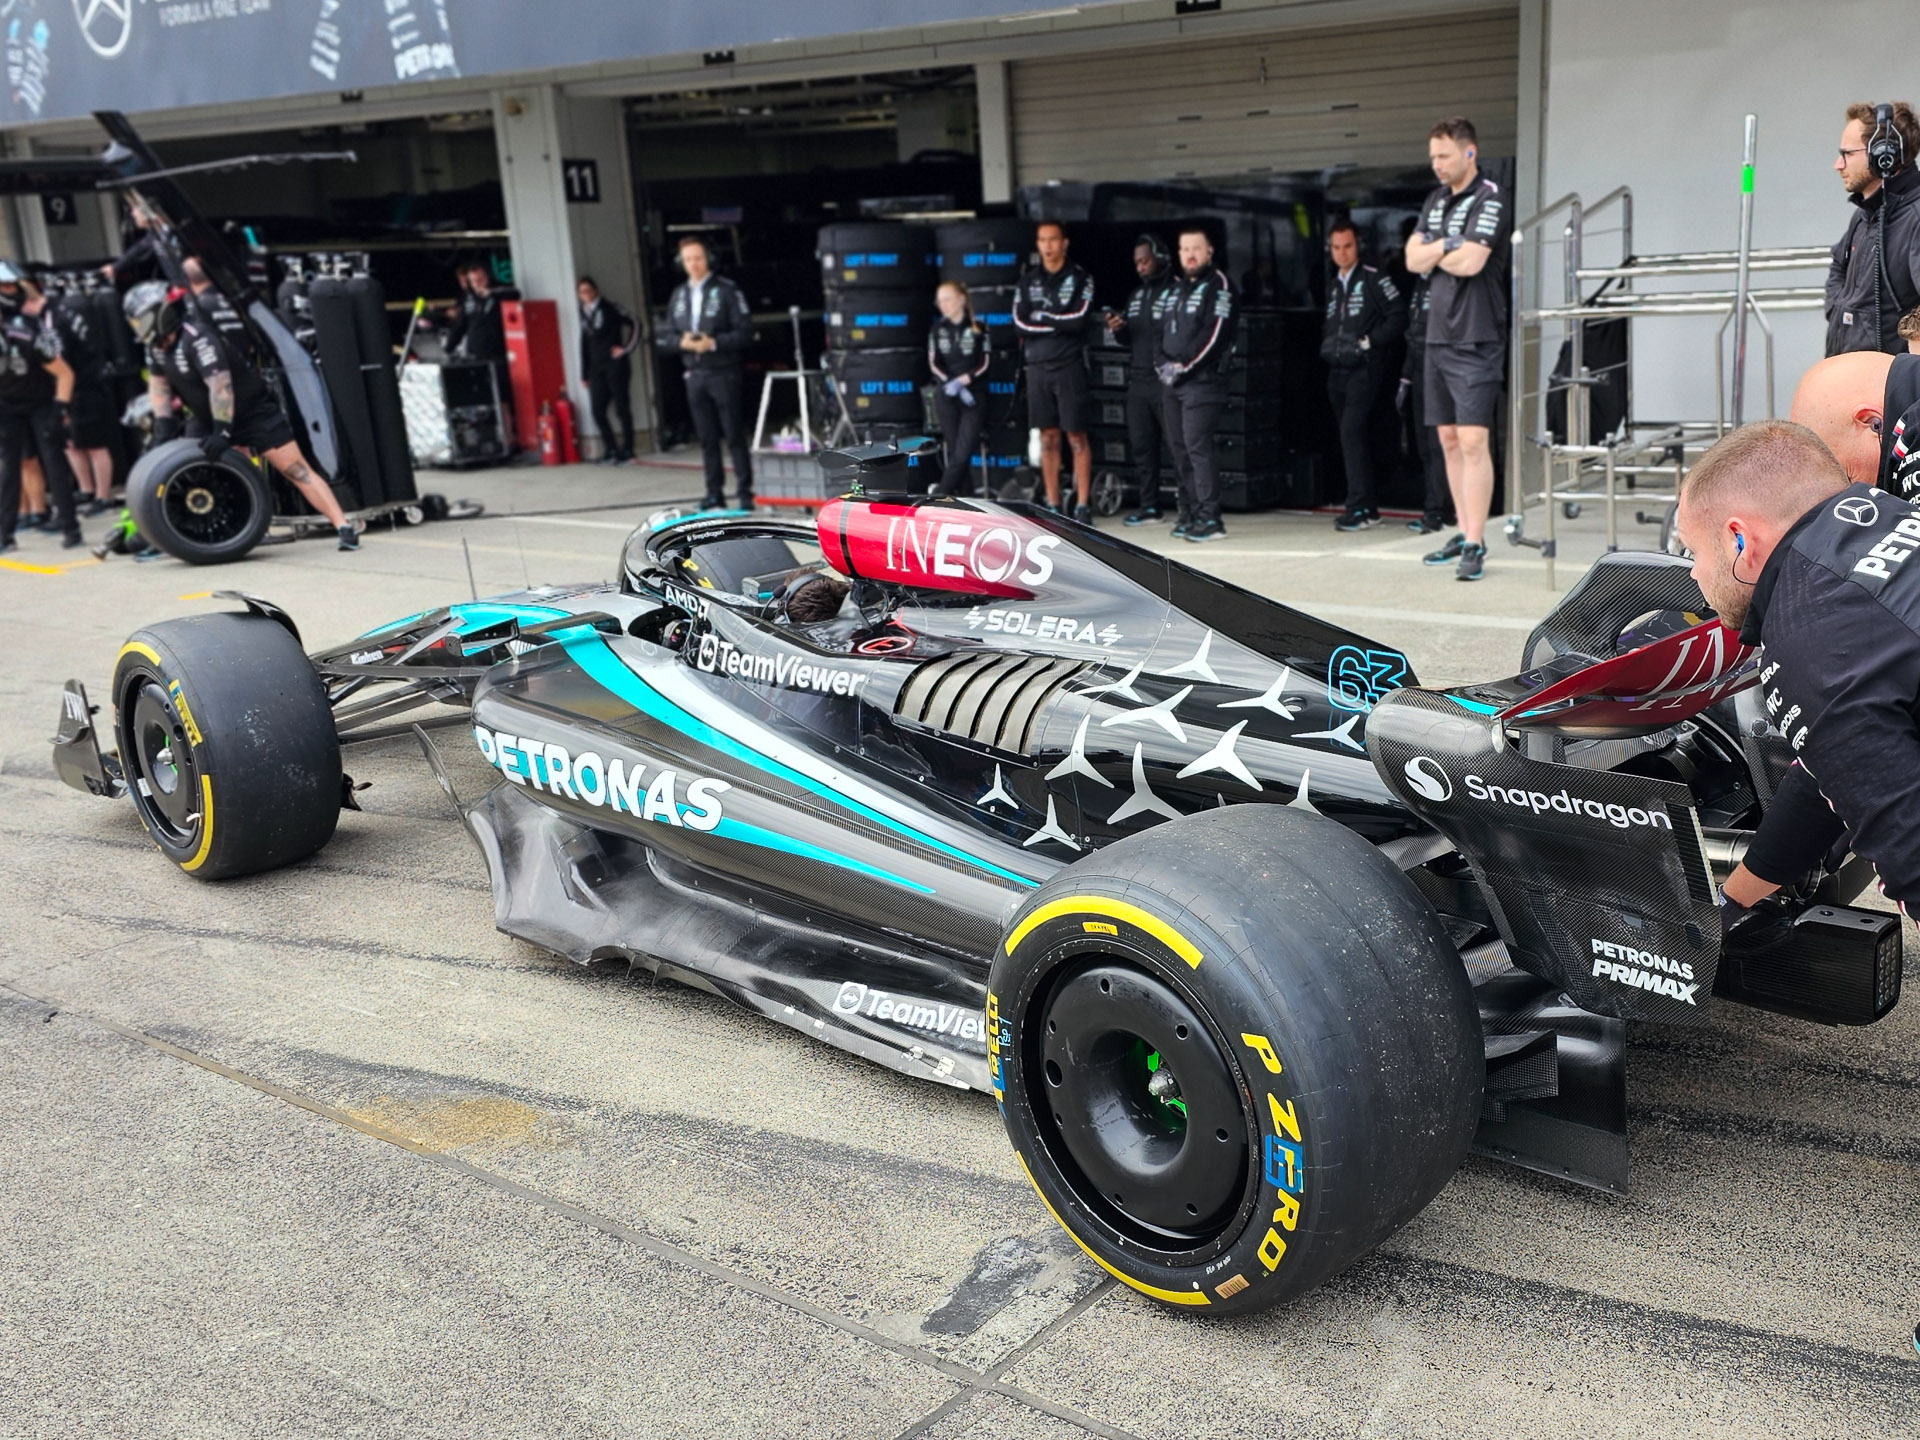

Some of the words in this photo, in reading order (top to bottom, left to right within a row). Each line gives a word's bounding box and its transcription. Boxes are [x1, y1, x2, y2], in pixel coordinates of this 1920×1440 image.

[566, 166, 595, 198] 11
[51, 197, 66, 221] 9
[886, 517, 1062, 587] INEOS
[665, 585, 698, 613] AMD
[983, 608, 1097, 644] SOLERA
[718, 640, 868, 697] TeamViewer
[1328, 645, 1407, 714] 63
[474, 724, 733, 832] PETRONAS
[1464, 774, 1673, 830] Snapdragon
[1591, 939, 1695, 980] PETRONAS
[1591, 959, 1701, 1006] PRIMAX
[866, 989, 987, 1042] TeamVie
[1240, 1032, 1283, 1075] P
